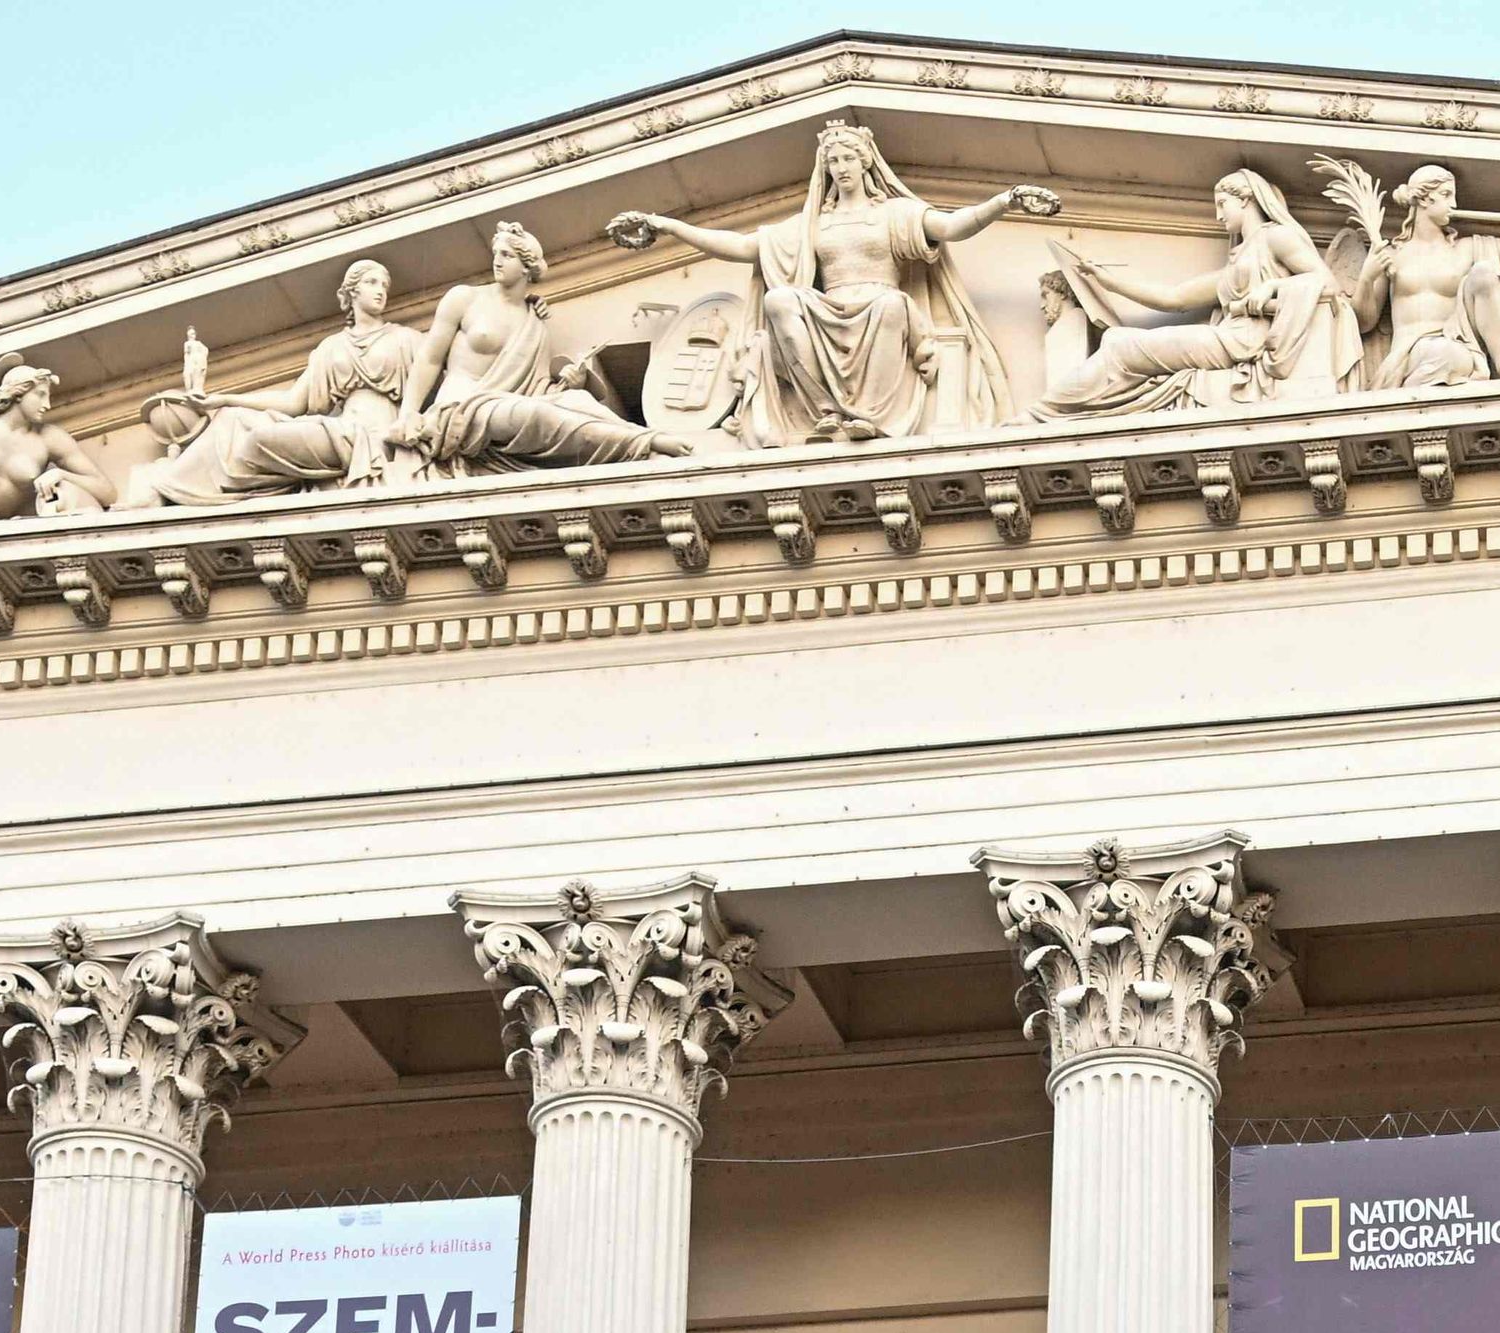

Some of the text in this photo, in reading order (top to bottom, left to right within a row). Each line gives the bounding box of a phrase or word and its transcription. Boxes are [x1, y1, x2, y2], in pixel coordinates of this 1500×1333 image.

[1349, 1195, 1475, 1226] NATIONAL
[222, 1252, 232, 1265] A
[239, 1248, 283, 1265] World
[290, 1248, 327, 1263] Press
[333, 1244, 375, 1260] Photo
[429, 1237, 492, 1254] kiállítása
[1349, 1246, 1476, 1272] MAGYARORSZÁG
